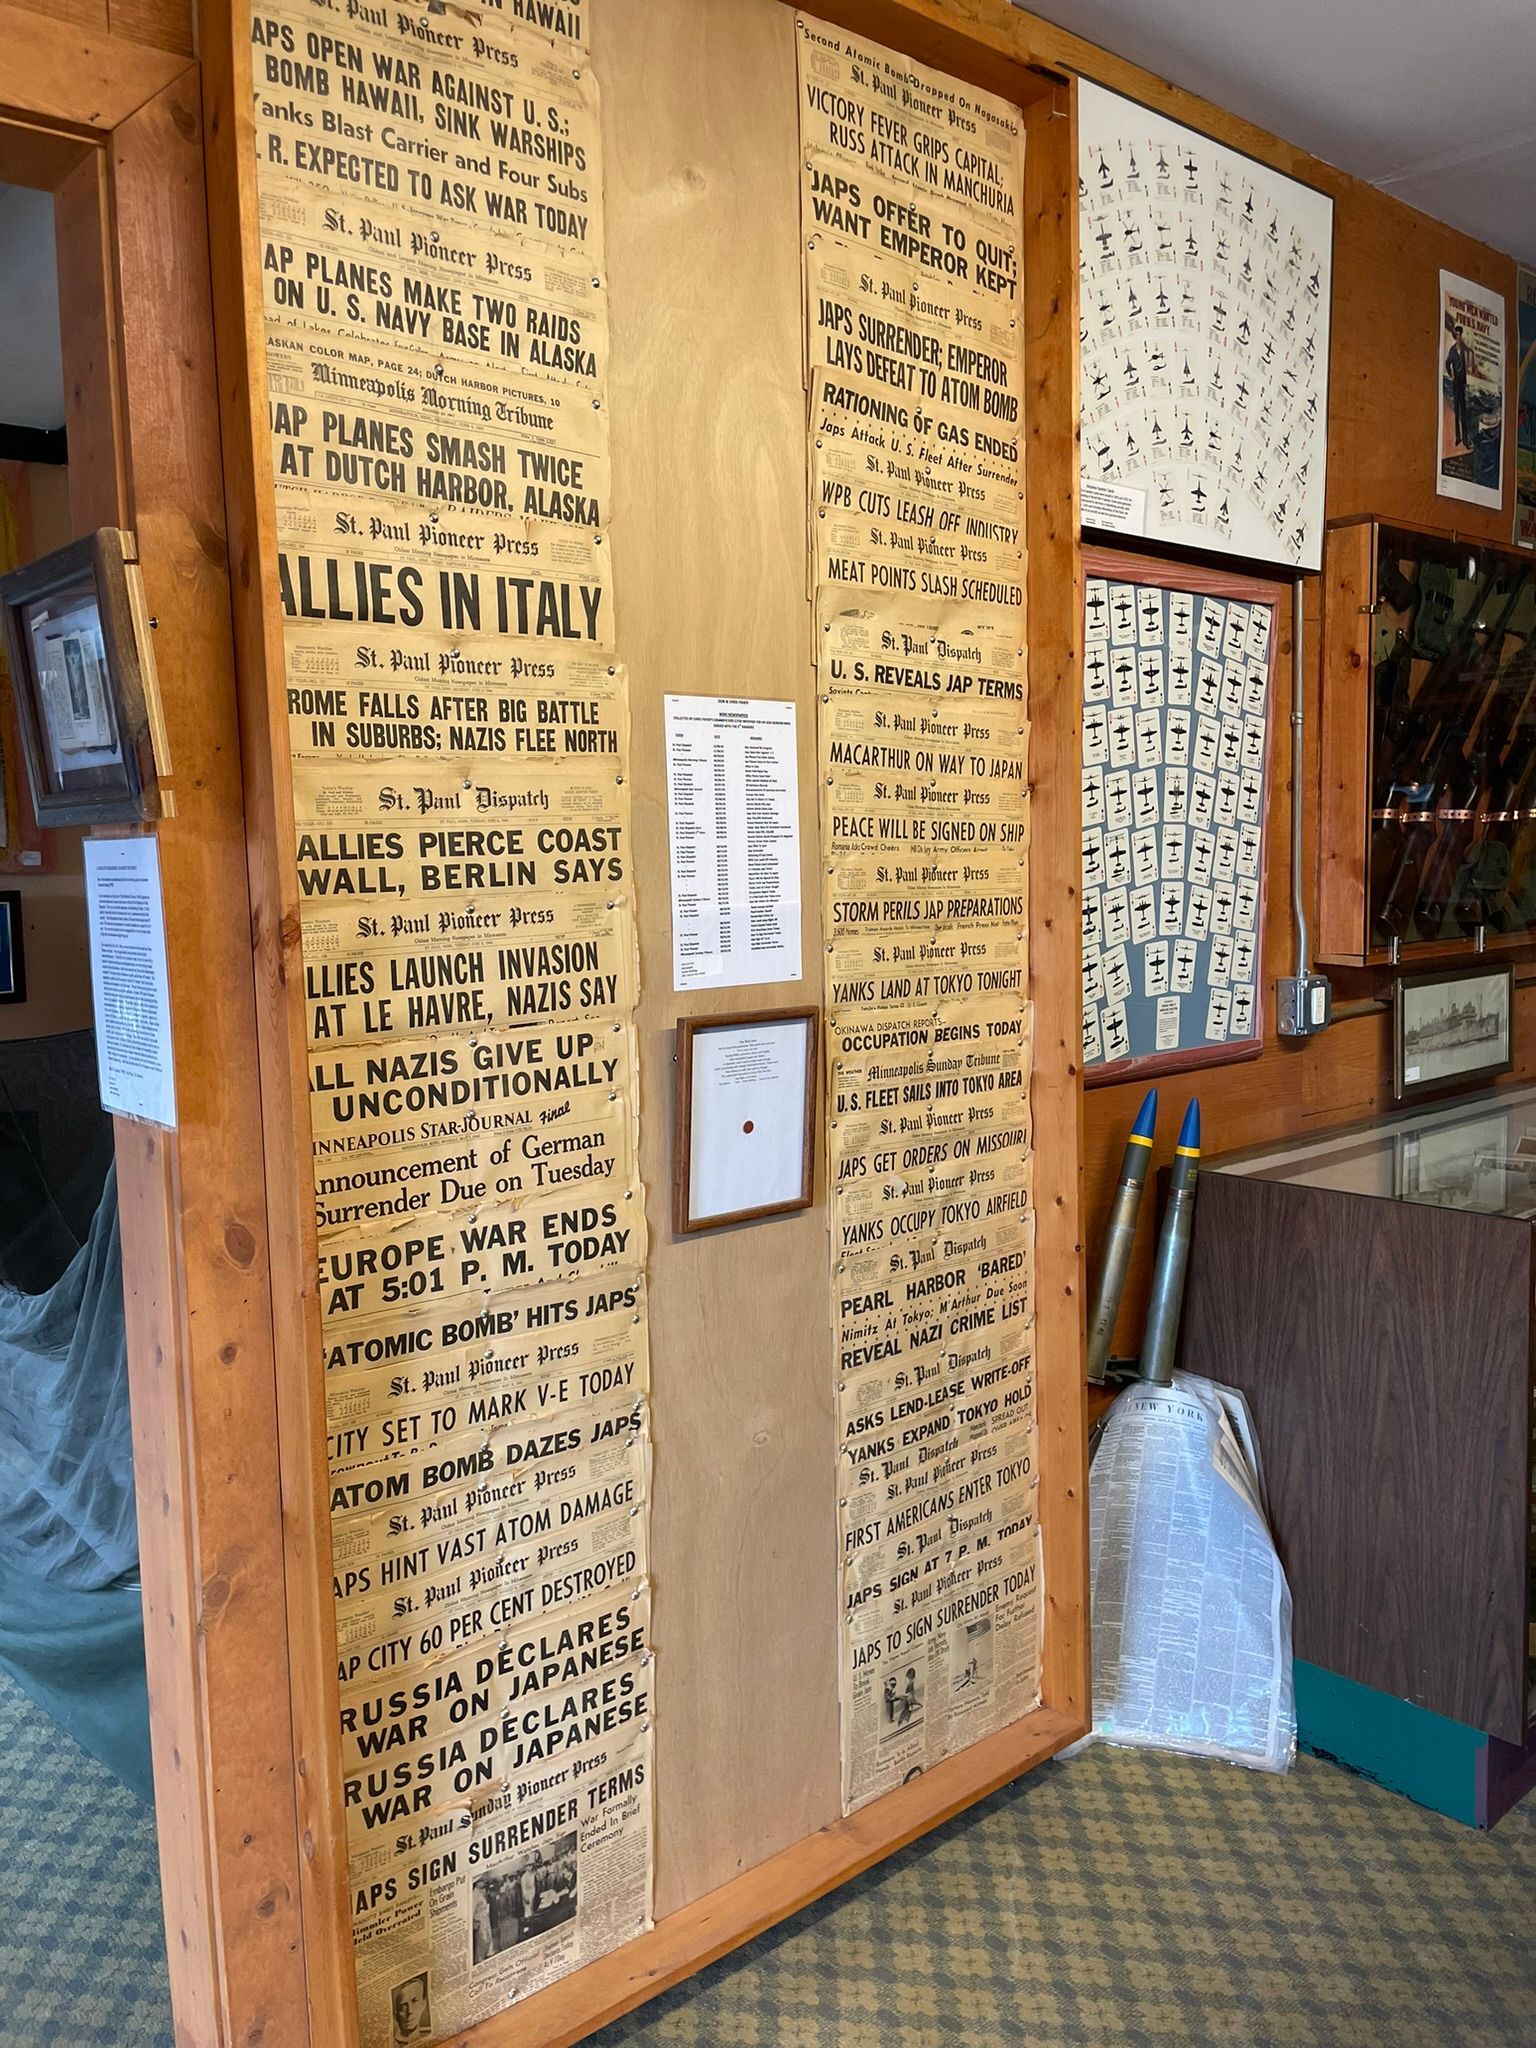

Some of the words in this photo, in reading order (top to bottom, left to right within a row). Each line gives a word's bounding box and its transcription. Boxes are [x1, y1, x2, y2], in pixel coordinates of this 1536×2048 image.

[513, 1, 581, 40] HAWAII
[804, 28, 840, 51] Second
[846, 46, 881, 70] Atomic
[885, 64, 909, 83] Bomb
[912, 77, 955, 103] Dropped
[959, 96, 971, 111] On
[975, 105, 1014, 131] Nagasaki
[266, 54, 329, 96] BOMB
[342, 75, 424, 123] HAWAII,
[434, 103, 480, 141] SINK
[491, 119, 587, 172] WARSHIPS
[807, 83, 864, 127] VICTORY
[871, 111, 907, 147] FEVER
[914, 131, 948, 163] GRIPS
[956, 149, 1004, 188] CAPITAL;
[322, 110, 373, 142] Blast
[381, 127, 448, 163] Carrier
[455, 154, 491, 176] and
[498, 160, 540, 189] Four
[547, 175, 588, 203] Subs
[811, 170, 861, 207] JAPS
[873, 195, 931, 238] OFFER
[942, 223, 966, 251] TO
[976, 239, 1017, 277] QUIT;
[812, 197, 871, 239] WANT
[881, 225, 968, 280] EMPEROR
[976, 265, 1017, 300] KEPT
[309, 345, 344, 360] COLOR
[349, 353, 373, 367] MAP,
[378, 359, 403, 373] PAGE
[426, 371, 456, 386] DUTCH
[461, 378, 499, 393] HARBOR
[502, 387, 547, 405] PICTURES,
[550, 398, 560, 407] 10
[312, 362, 415, 402] Minneapolis
[421, 387, 491, 422] Morning
[496, 400, 554, 430] Tribune
[823, 382, 908, 428] RATIONING
[914, 413, 933, 435] OF
[937, 421, 969, 446] GAS
[975, 432, 1018, 463] ENDED
[820, 418, 845, 437] Japs
[851, 427, 885, 449] Attack
[891, 439, 901, 452] U.
[906, 443, 914, 457] S.
[919, 447, 942, 466] Fleet
[947, 456, 973, 473] After
[977, 464, 1018, 486] Surrender
[279, 553, 424, 627] ALLIES
[439, 571, 481, 631] IN
[496, 576, 602, 641] ITALY
[830, 659, 847, 679] U.
[853, 662, 869, 682] S.
[875, 665, 941, 691] REVEALS
[946, 675, 973, 694] JAP
[978, 678, 1023, 700] TERMS
[288, 688, 347, 716] ROME
[359, 692, 419, 720] FALLS
[430, 697, 488, 722] AFTER
[499, 699, 527, 723] BIG
[537, 701, 599, 725] BATTLE
[830, 742, 910, 770] MACARTHUR
[916, 752, 933, 772] ON
[939, 754, 965, 775] WAY
[970, 757, 985, 775] TO
[989, 760, 1023, 780] JAPAN
[378, 786, 410, 812] St.
[414, 787, 462, 815] Paul
[475, 787, 550, 813] Dispatch
[297, 832, 404, 862] ALLIES
[419, 830, 524, 858] PIERCE
[537, 827, 622, 854] COAST
[833, 816, 874, 838] PEACE
[879, 818, 908, 839] WILL
[913, 820, 926, 840] BE
[931, 821, 975, 842] SIGNED
[979, 823, 996, 842] ON
[1000, 824, 1025, 843] SHIP
[861, 843, 878, 851] Crowd
[880, 844, 900, 852] Cheers
[298, 866, 407, 897] WALL,
[421, 861, 536, 891] BERLIN
[554, 857, 623, 884] SAYS
[356, 916, 385, 939] St.
[390, 912, 430, 936] Paul
[438, 907, 502, 932] Pioneer
[510, 906, 554, 927] Press
[833, 901, 879, 923] STORM
[884, 900, 921, 921] PERILS
[924, 901, 944, 919] JAP
[947, 897, 1023, 918] PREPARATIONS
[957, 922, 974, 930] French
[835, 1023, 875, 1035] OKINAWA
[877, 1020, 911, 1031] DISPATCH
[842, 1030, 928, 1052] OCCUPATION
[934, 1026, 980, 1043] BEGINS
[986, 1020, 1023, 1036] TODAY
[867, 1061, 924, 1082] Minneapolis
[927, 1058, 963, 1072] Sunday
[966, 1053, 1000, 1067] Tribune
[332, 1059, 619, 1123] UNCONDITIONALLY
[420, 1112, 533, 1139] STAR-JOURNAL
[539, 1100, 572, 1126] Final
[490, 1139, 511, 1165] of
[522, 1131, 605, 1159] German
[441, 1178, 487, 1204] Due
[496, 1172, 522, 1194] on
[531, 1156, 616, 1188] Tuesday
[328, 1283, 364, 1314] AT
[382, 1268, 444, 1303] 5:01
[462, 1260, 487, 1285] P.
[503, 1250, 534, 1277] M.
[548, 1229, 631, 1266] TODAY
[842, 1325, 878, 1343] Nimitz
[885, 1319, 896, 1332] At
[986, 1287, 1004, 1300] Due
[1009, 1280, 1027, 1293] Soon
[846, 1412, 884, 1437] ASKS
[890, 1381, 965, 1421] LEND-LEASE
[971, 1355, 1031, 1391] WRITE-OFF
[992, 1411, 1015, 1425] SPREAD
[1017, 1403, 1029, 1414] OUT
[1167, 1405, 1203, 1421] YORK
[381, 1548, 429, 1585] HINT
[437, 1529, 486, 1566] VAST
[495, 1509, 552, 1546] ATOM
[560, 1480, 634, 1526] DAMAGE
[852, 1642, 882, 1670] JAPS
[886, 1631, 901, 1653] TO
[907, 1614, 932, 1645] SIGN
[938, 1583, 999, 1624] SURRENDER
[1004, 1564, 1036, 1593] TODAY
[341, 1671, 463, 1735] RUSSIA
[476, 1606, 631, 1685] DECLARES
[361, 1785, 432, 1830] WAR
[454, 1757, 493, 1793] ON
[513, 1693, 648, 1768] JAPANESE
[409, 1851, 457, 1891] SIGN
[469, 1799, 578, 1864] SURRENDER
[588, 1764, 645, 1809] TERMS
[580, 1813, 599, 1828] War
[602, 1793, 639, 1819] Formally
[581, 1821, 608, 1842] Ended
[611, 1816, 619, 1829] In
[622, 1805, 642, 1823] Brief
[580, 1827, 624, 1854] Ceremony
[376, 1910, 421, 1936] Overrated
